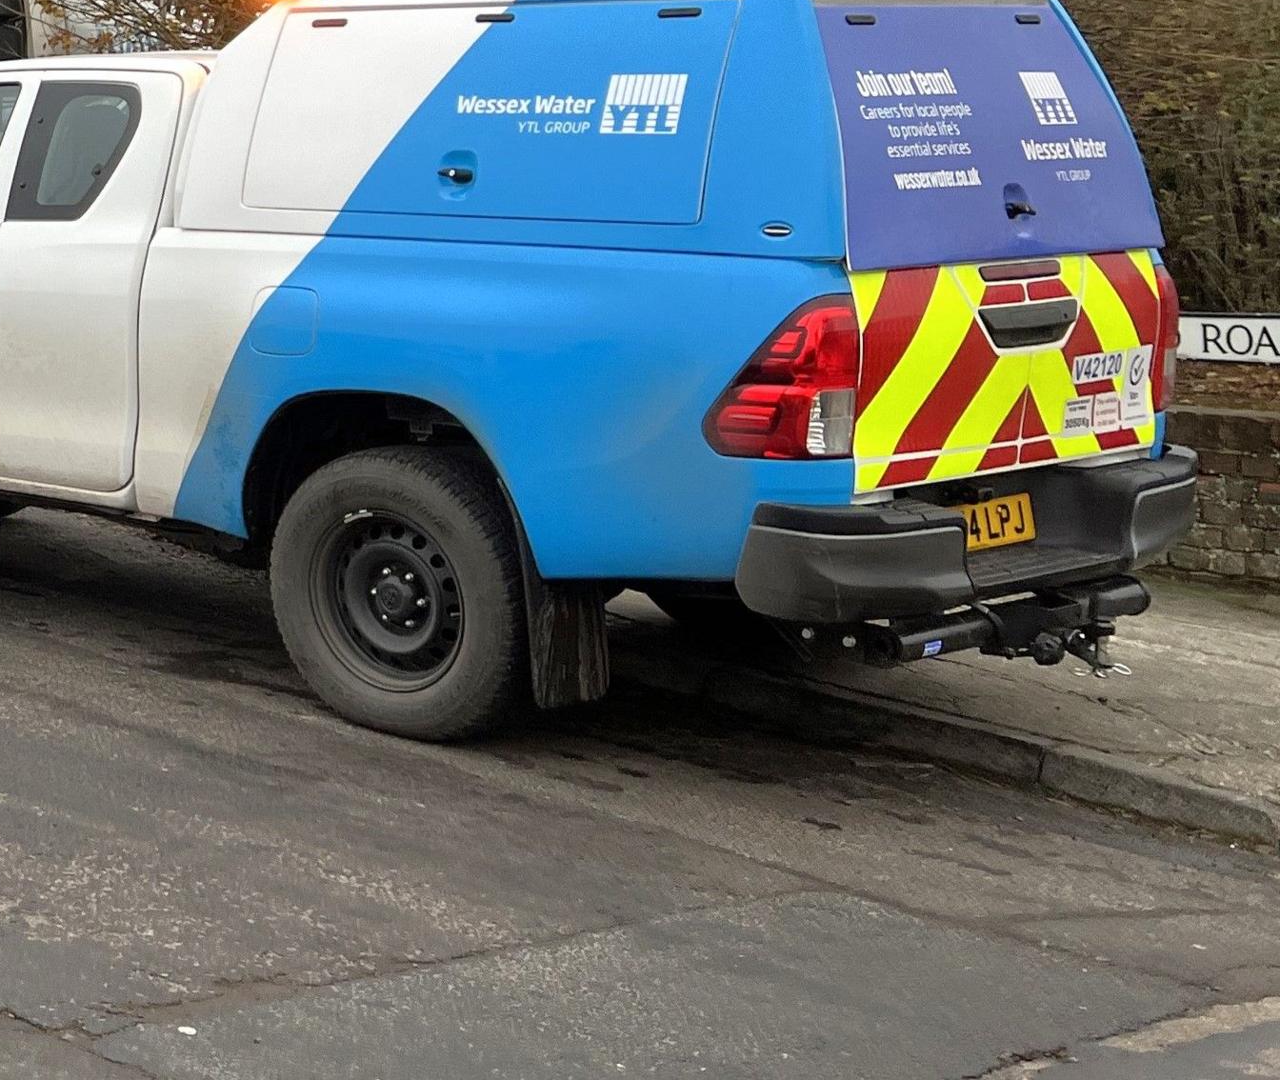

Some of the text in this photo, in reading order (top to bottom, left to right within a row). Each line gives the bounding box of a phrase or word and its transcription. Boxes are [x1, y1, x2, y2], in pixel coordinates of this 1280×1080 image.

[856, 68, 957, 97] Join our team!
[457, 95, 595, 114] Wessex Water
[860, 102, 973, 120] Careers for local people
[518, 121, 591, 134] YTL GROUP
[888, 121, 961, 140] to provide life's
[887, 140, 972, 158] essential services
[1021, 138, 1108, 160] Wessex Water
[894, 167, 982, 190] wessexwater.co.uk
[1201, 323, 1280, 356] ROA
[1076, 353, 1123, 381] V42120
[984, 501, 1025, 539] LPJ
